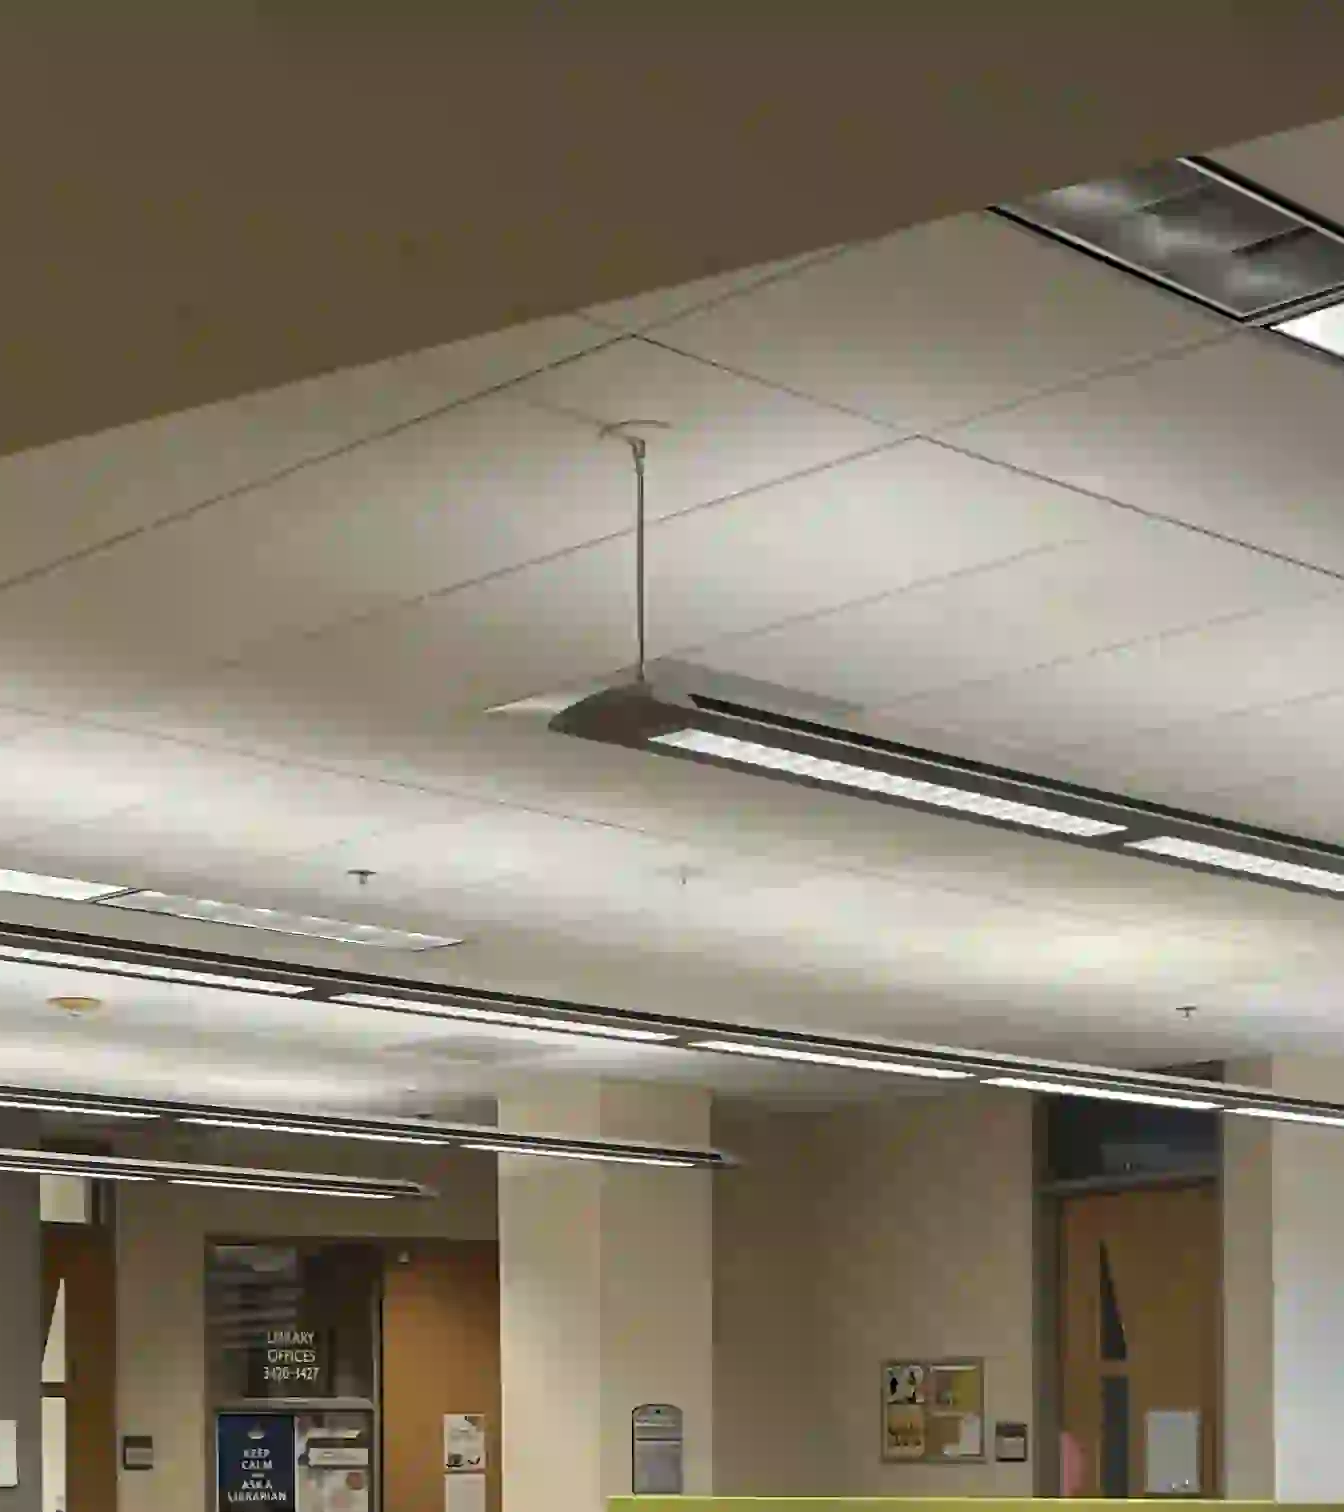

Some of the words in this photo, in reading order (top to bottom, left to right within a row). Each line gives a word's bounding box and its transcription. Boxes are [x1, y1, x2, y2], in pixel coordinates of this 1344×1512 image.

[267, 1349, 316, 1363] OFFICES
[243, 1448, 271, 1458] KEEP
[241, 1460, 273, 1470] CALM
